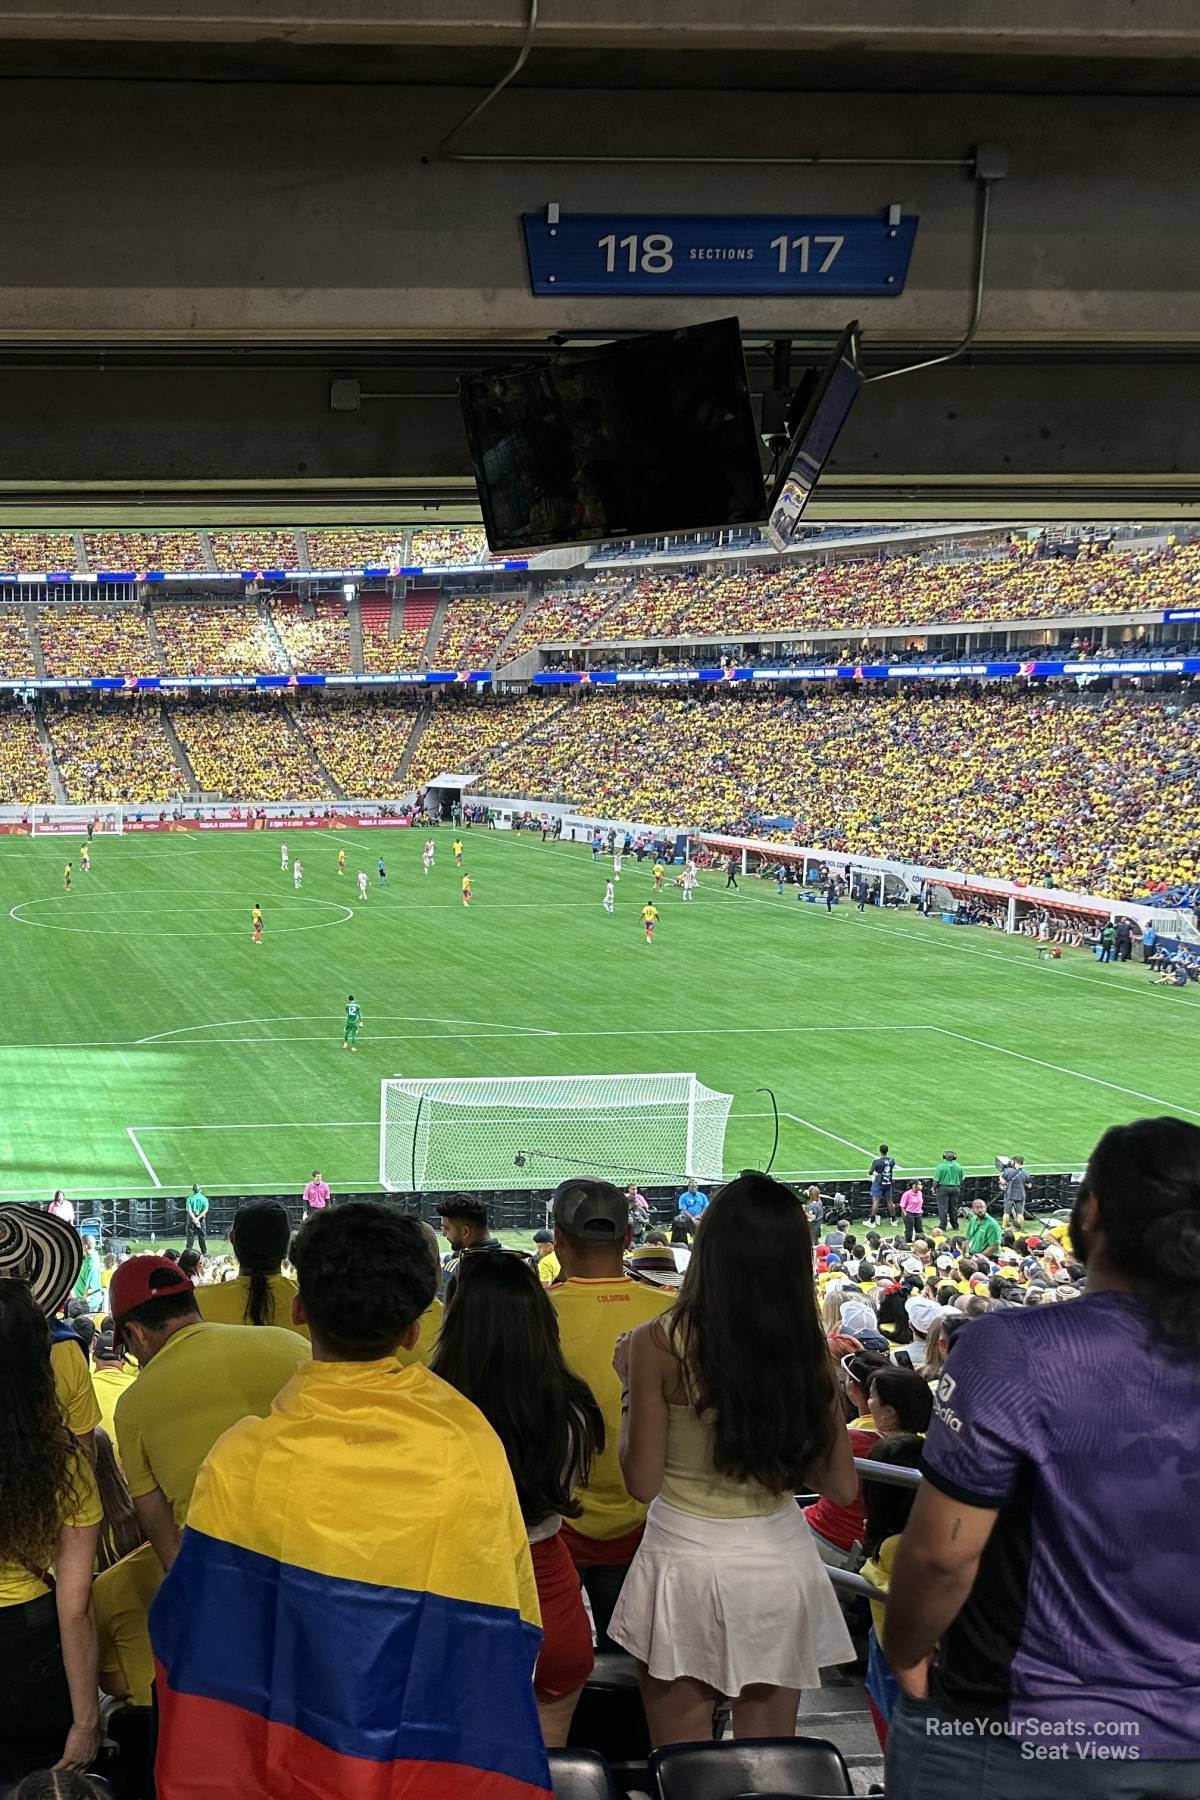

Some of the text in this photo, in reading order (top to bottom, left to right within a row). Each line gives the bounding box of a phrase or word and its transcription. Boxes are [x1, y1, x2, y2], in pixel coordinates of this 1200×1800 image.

[598, 234, 845, 274] 118 SECTIONS 117
[348, 1006, 356, 1015] 12
